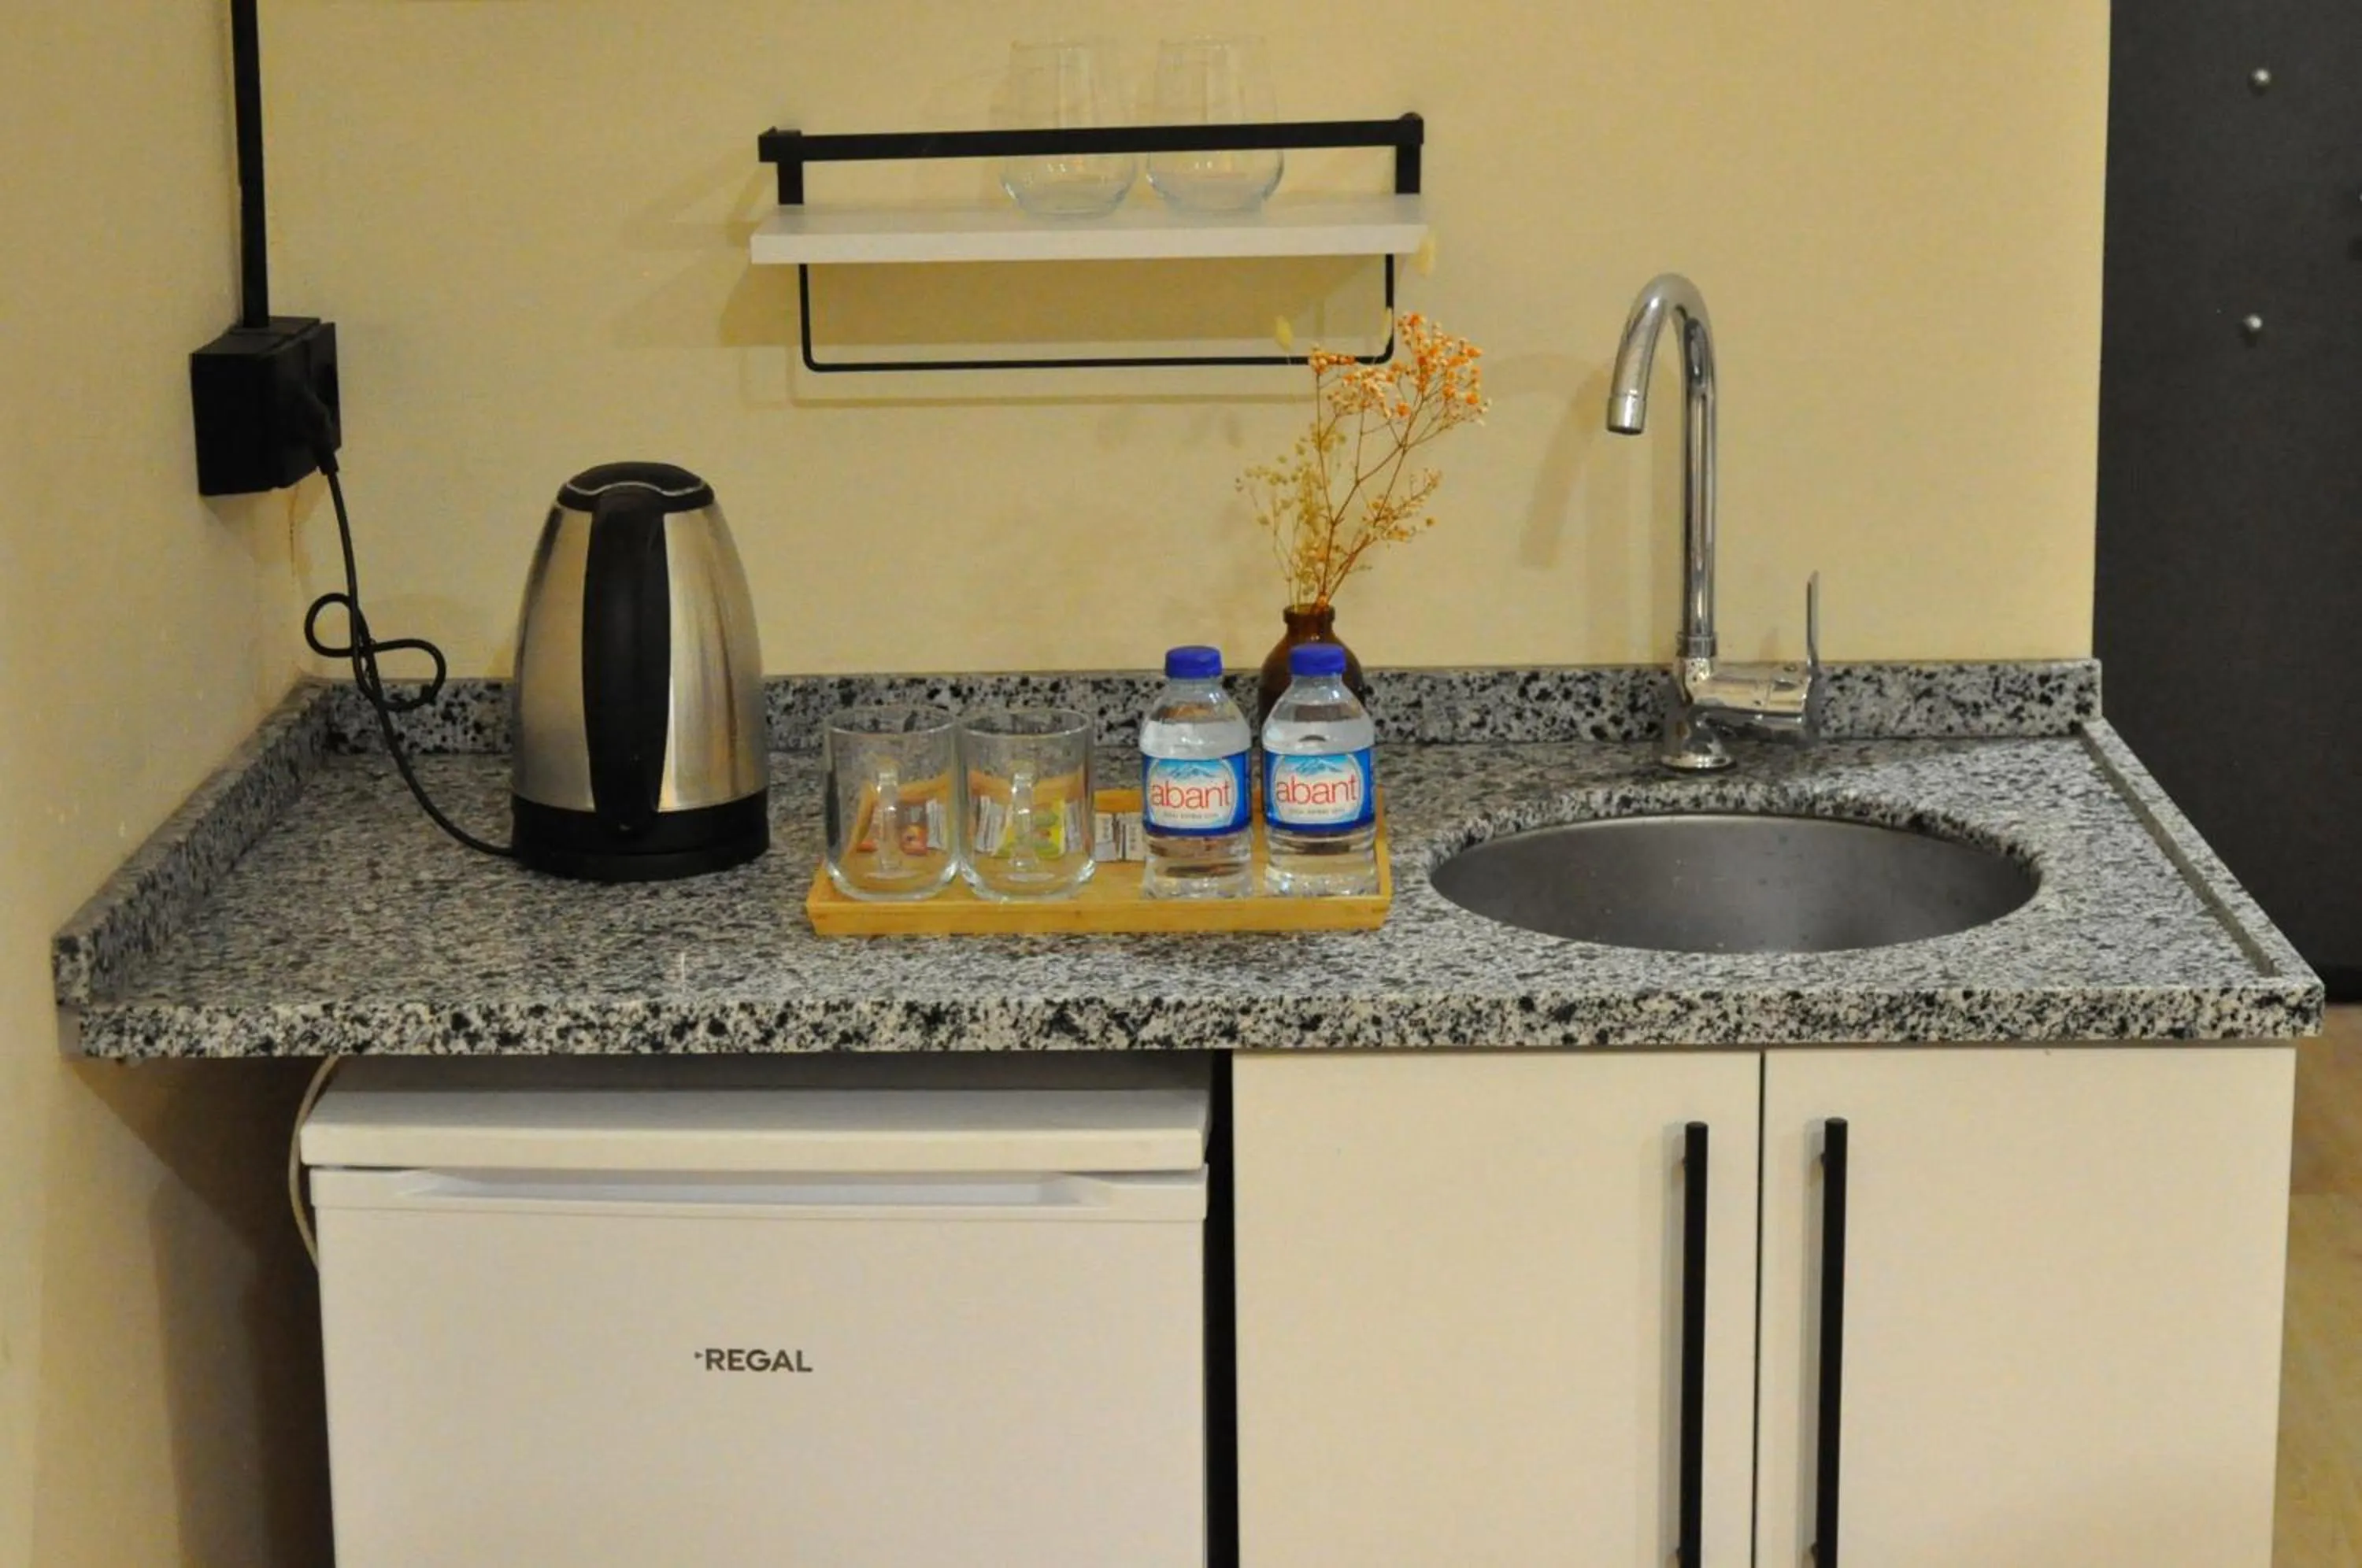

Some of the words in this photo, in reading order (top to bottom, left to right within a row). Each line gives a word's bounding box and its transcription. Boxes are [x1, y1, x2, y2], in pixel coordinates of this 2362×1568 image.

[1151, 780, 1230, 809] abant
[1276, 774, 1357, 804] abant
[705, 1348, 813, 1373] REGAL
